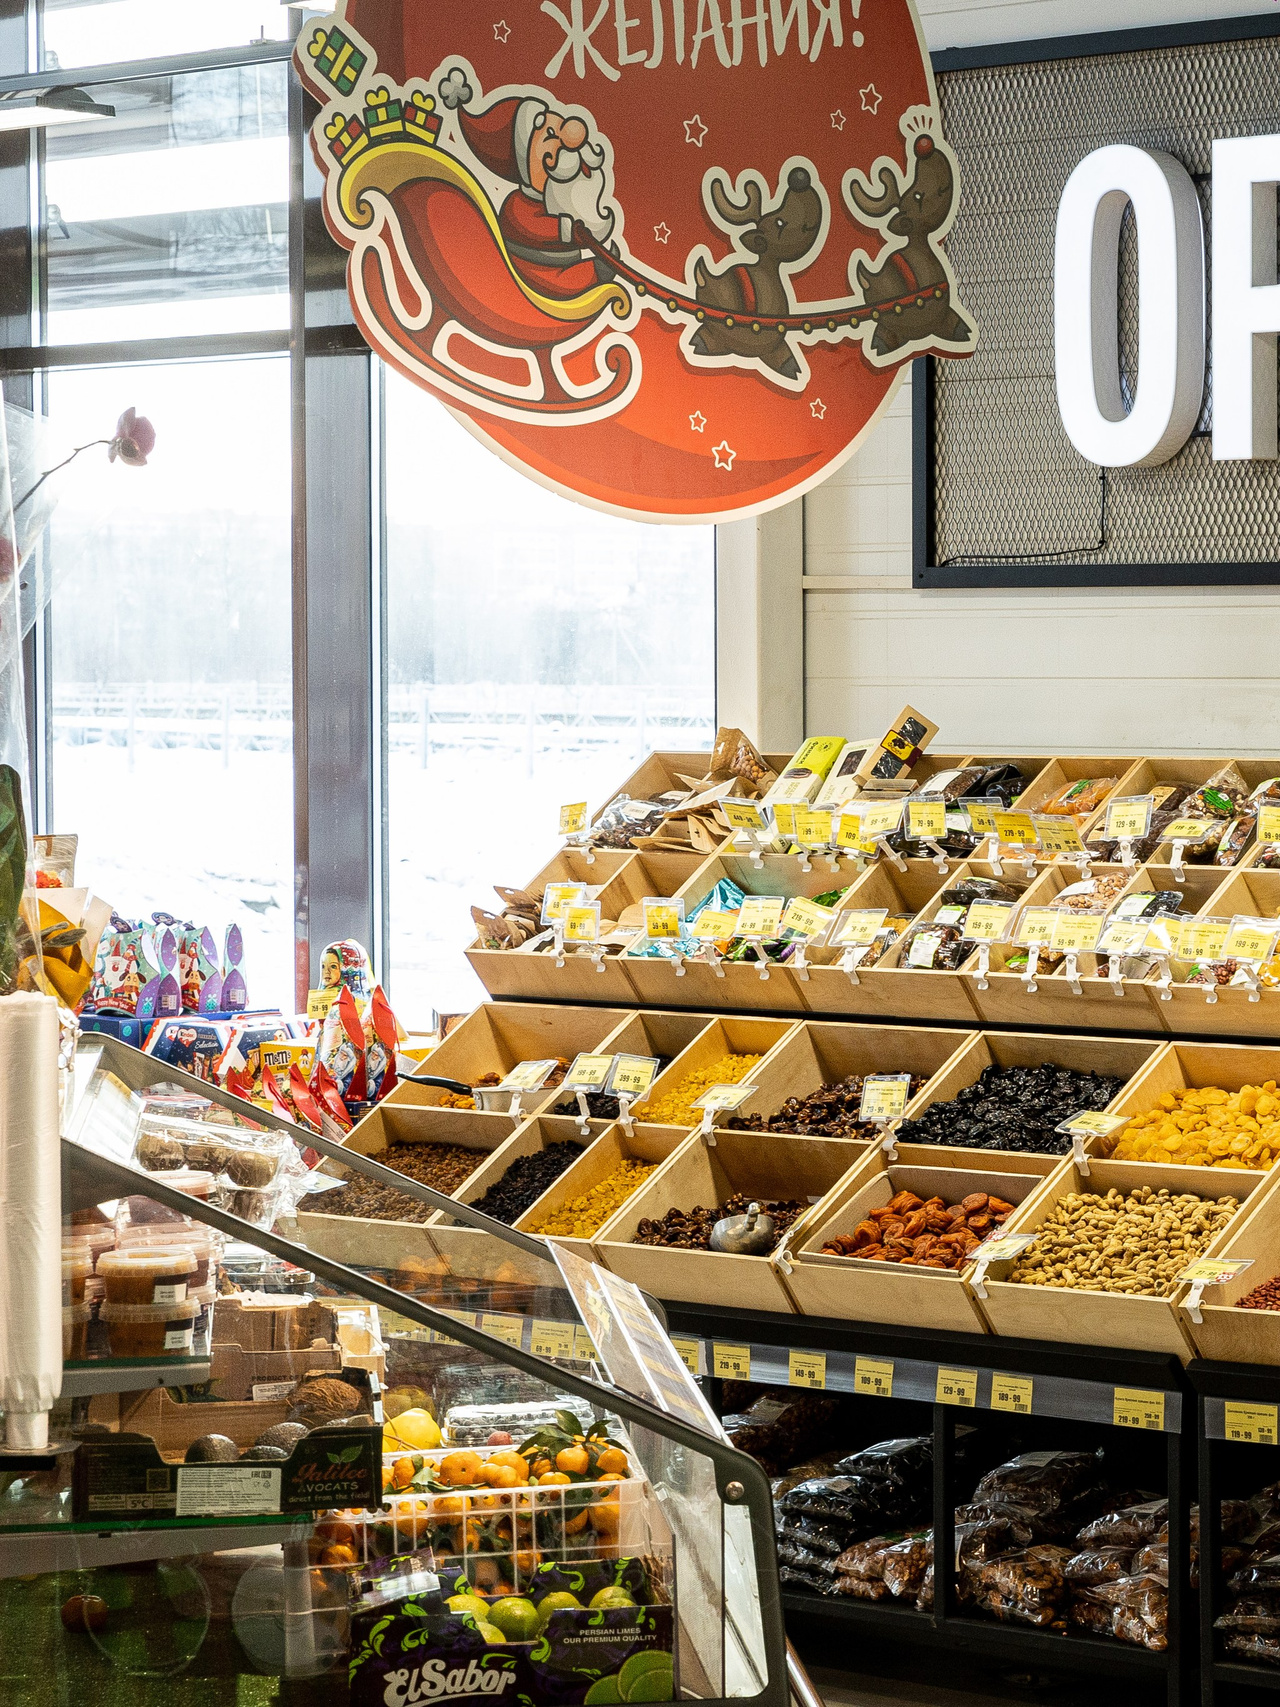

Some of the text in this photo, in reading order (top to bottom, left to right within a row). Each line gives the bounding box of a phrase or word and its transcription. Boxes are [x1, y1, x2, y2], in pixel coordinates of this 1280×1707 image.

[540, 0, 865, 81] ЖЕЛАНИЯ!
[579, 1627, 641, 1637] PERSIAN LIMES
[563, 1634, 657, 1644] OUR PREMIUM QUALITY
